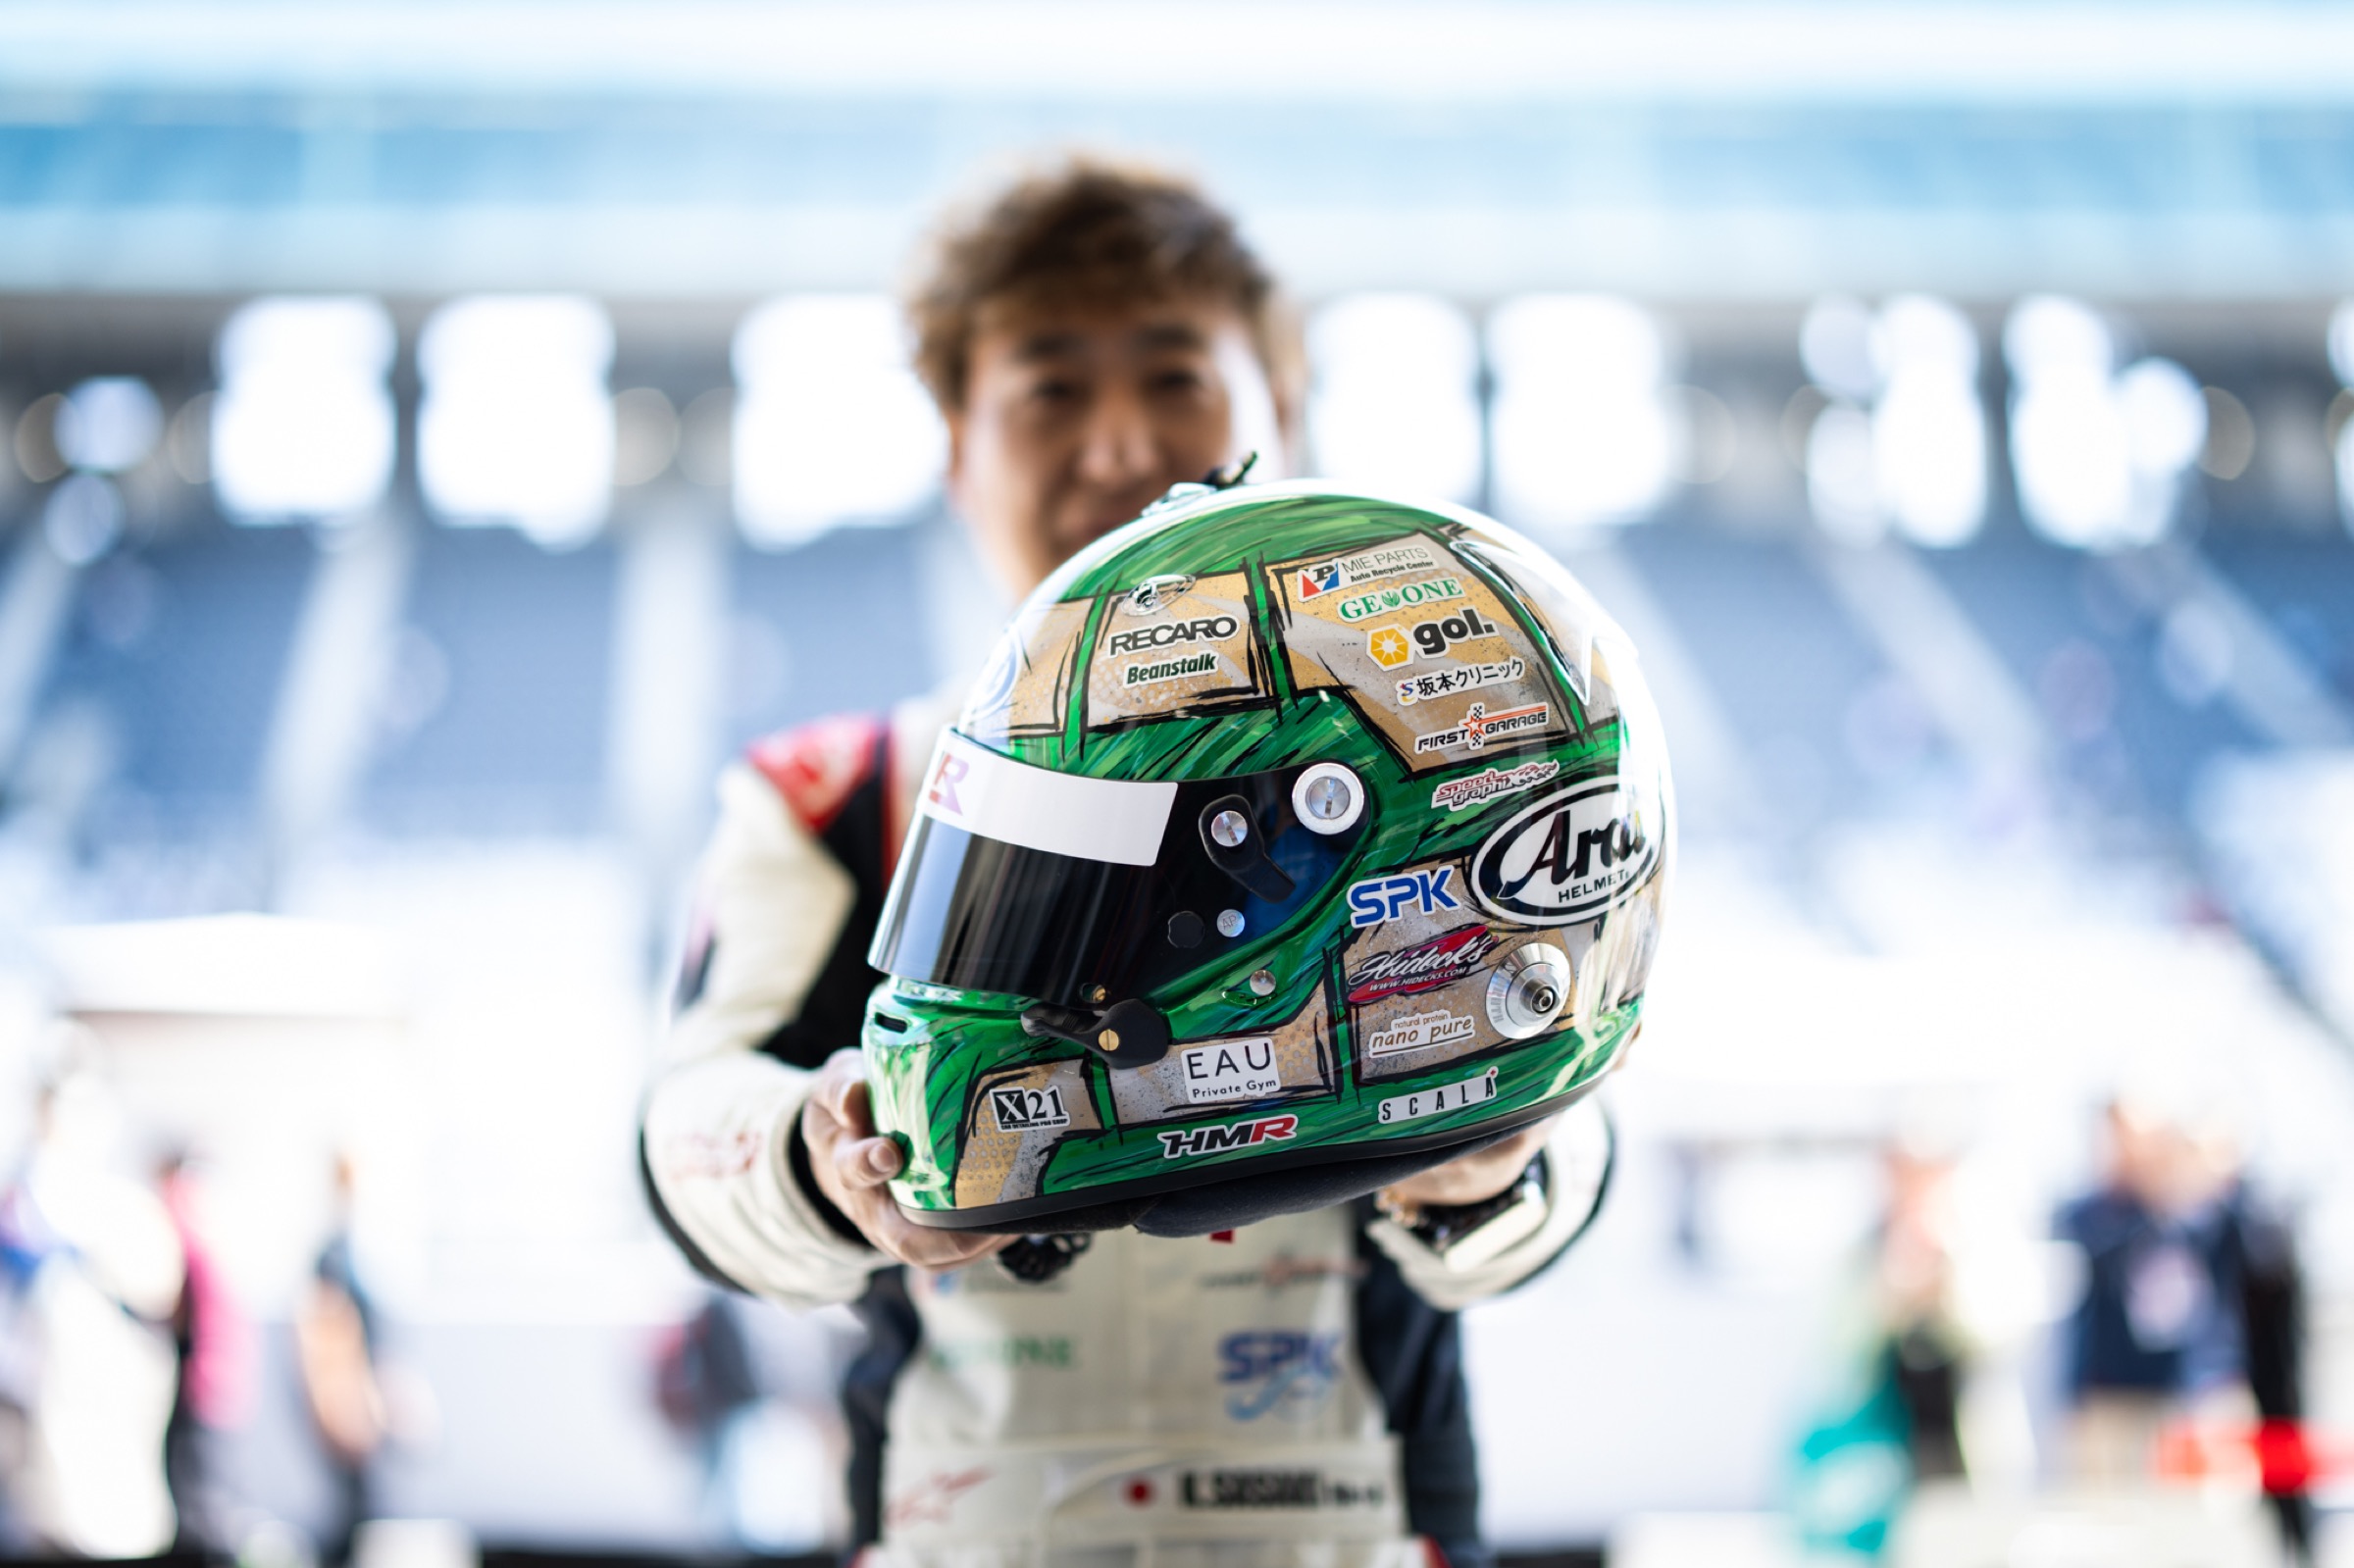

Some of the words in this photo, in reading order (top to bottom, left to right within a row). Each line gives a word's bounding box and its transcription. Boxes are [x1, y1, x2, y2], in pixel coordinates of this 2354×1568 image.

[1342, 556, 1373, 574] MIE
[1375, 547, 1429, 565] PARTS
[1350, 572, 1371, 582] Auto
[1373, 565, 1406, 578] Recycle
[1407, 561, 1434, 570] Center
[1110, 617, 1237, 656] RECARO
[1127, 653, 1216, 684] Beanstalk
[1416, 659, 1523, 696] 坂本クリニック
[1418, 729, 1469, 751] FIRST
[1485, 711, 1547, 734] GARAGE
[1438, 770, 1497, 798] speed
[1350, 869, 1458, 926] SPK
[1371, 1030, 1418, 1048] nano
[1429, 1018, 1472, 1042] pure
[1395, 1016, 1420, 1028] natural
[1423, 1013, 1449, 1025] protein
[1187, 1042, 1271, 1080] EAU
[1192, 1085, 1242, 1098] Private
[1246, 1079, 1277, 1091] Gym
[1382, 1077, 1494, 1121] SCALA
[995, 1089, 1067, 1123] X21
[1160, 1116, 1296, 1156] HMR
